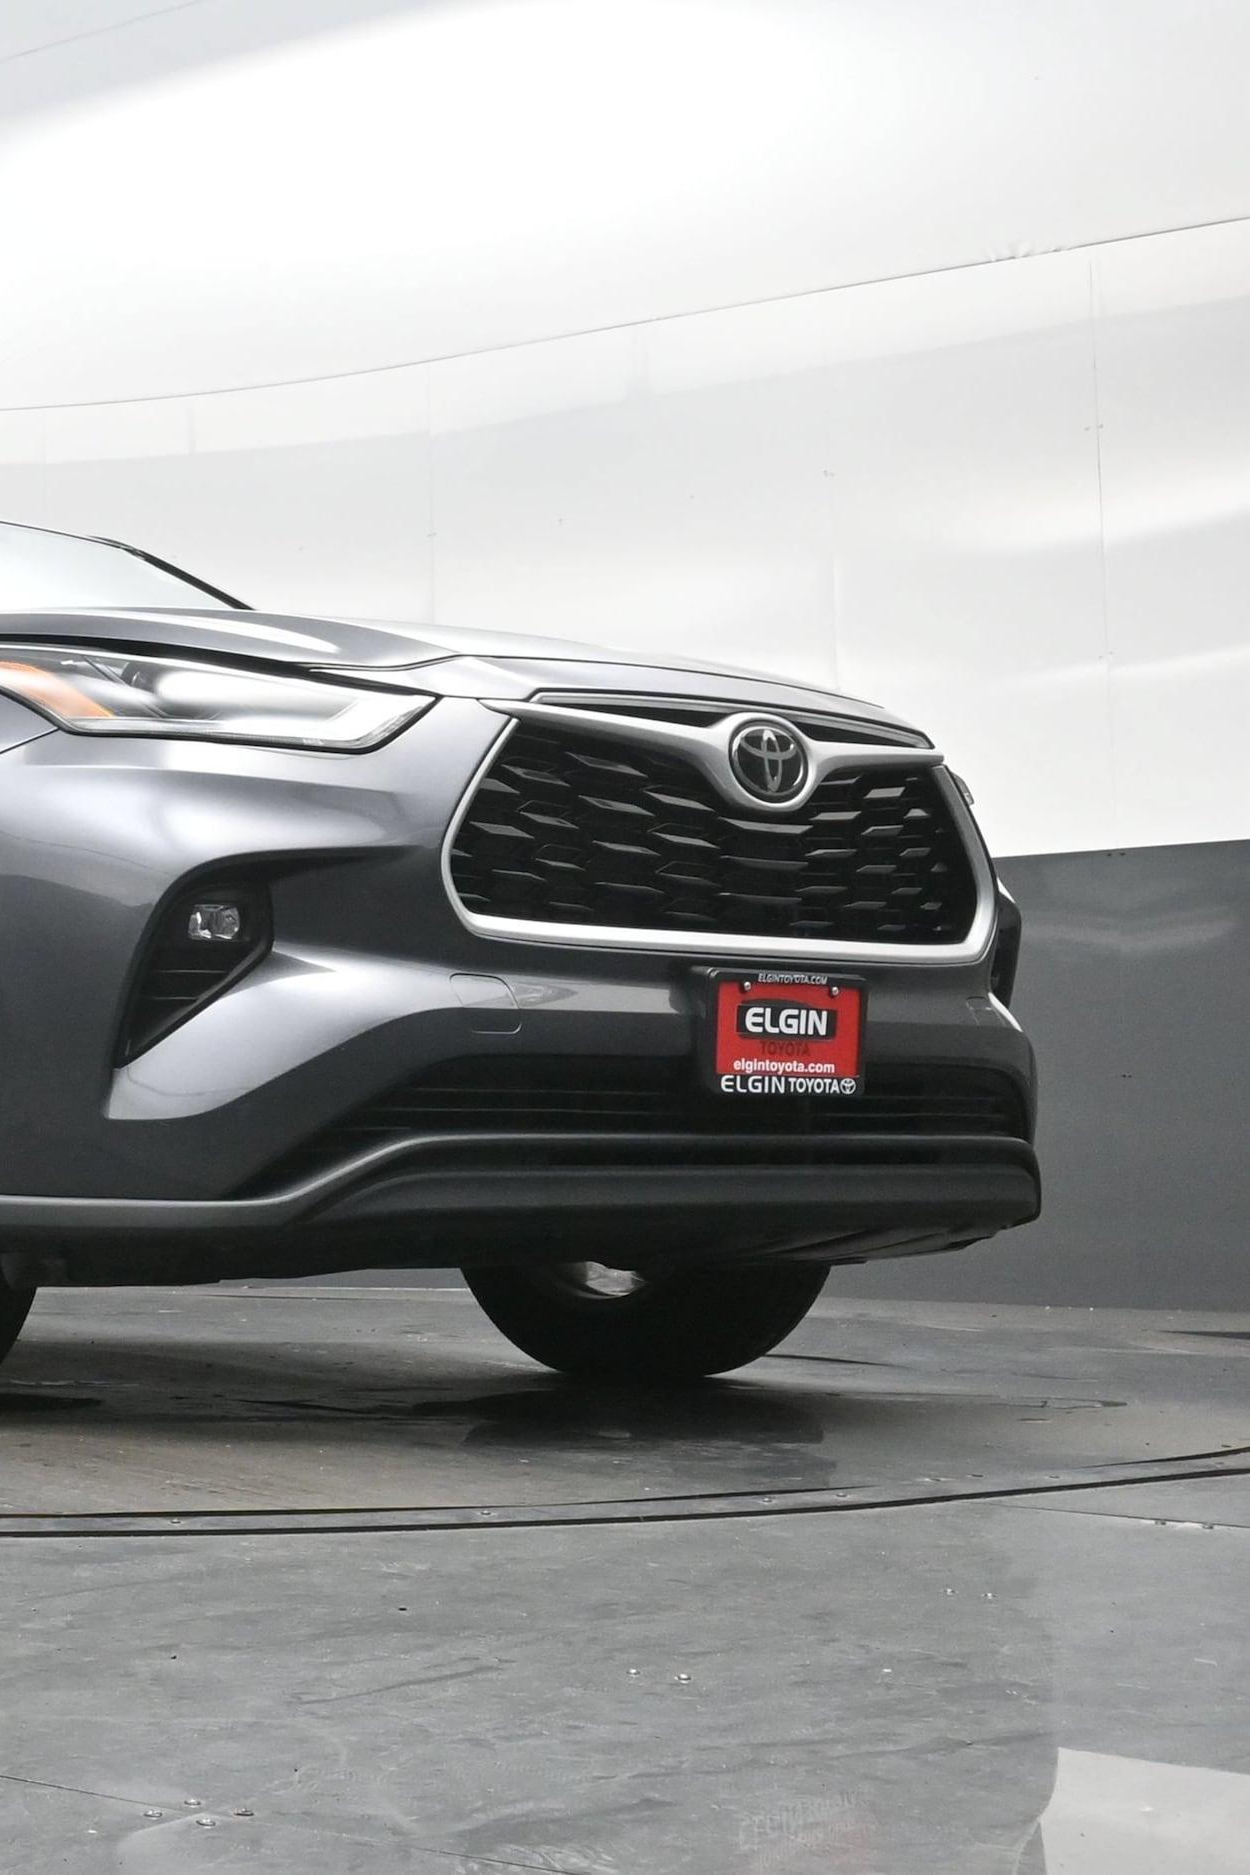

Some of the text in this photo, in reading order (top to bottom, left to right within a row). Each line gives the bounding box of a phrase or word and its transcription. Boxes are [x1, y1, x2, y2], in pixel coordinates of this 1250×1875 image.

[758, 973, 828, 985] ELGINTOYOTA.COM
[745, 1006, 828, 1036] ELGIN
[760, 1040, 811, 1057] TOYOTA
[733, 1057, 836, 1076] elgintoyota.com
[720, 1075, 841, 1094] ELGIN TOYOTA
